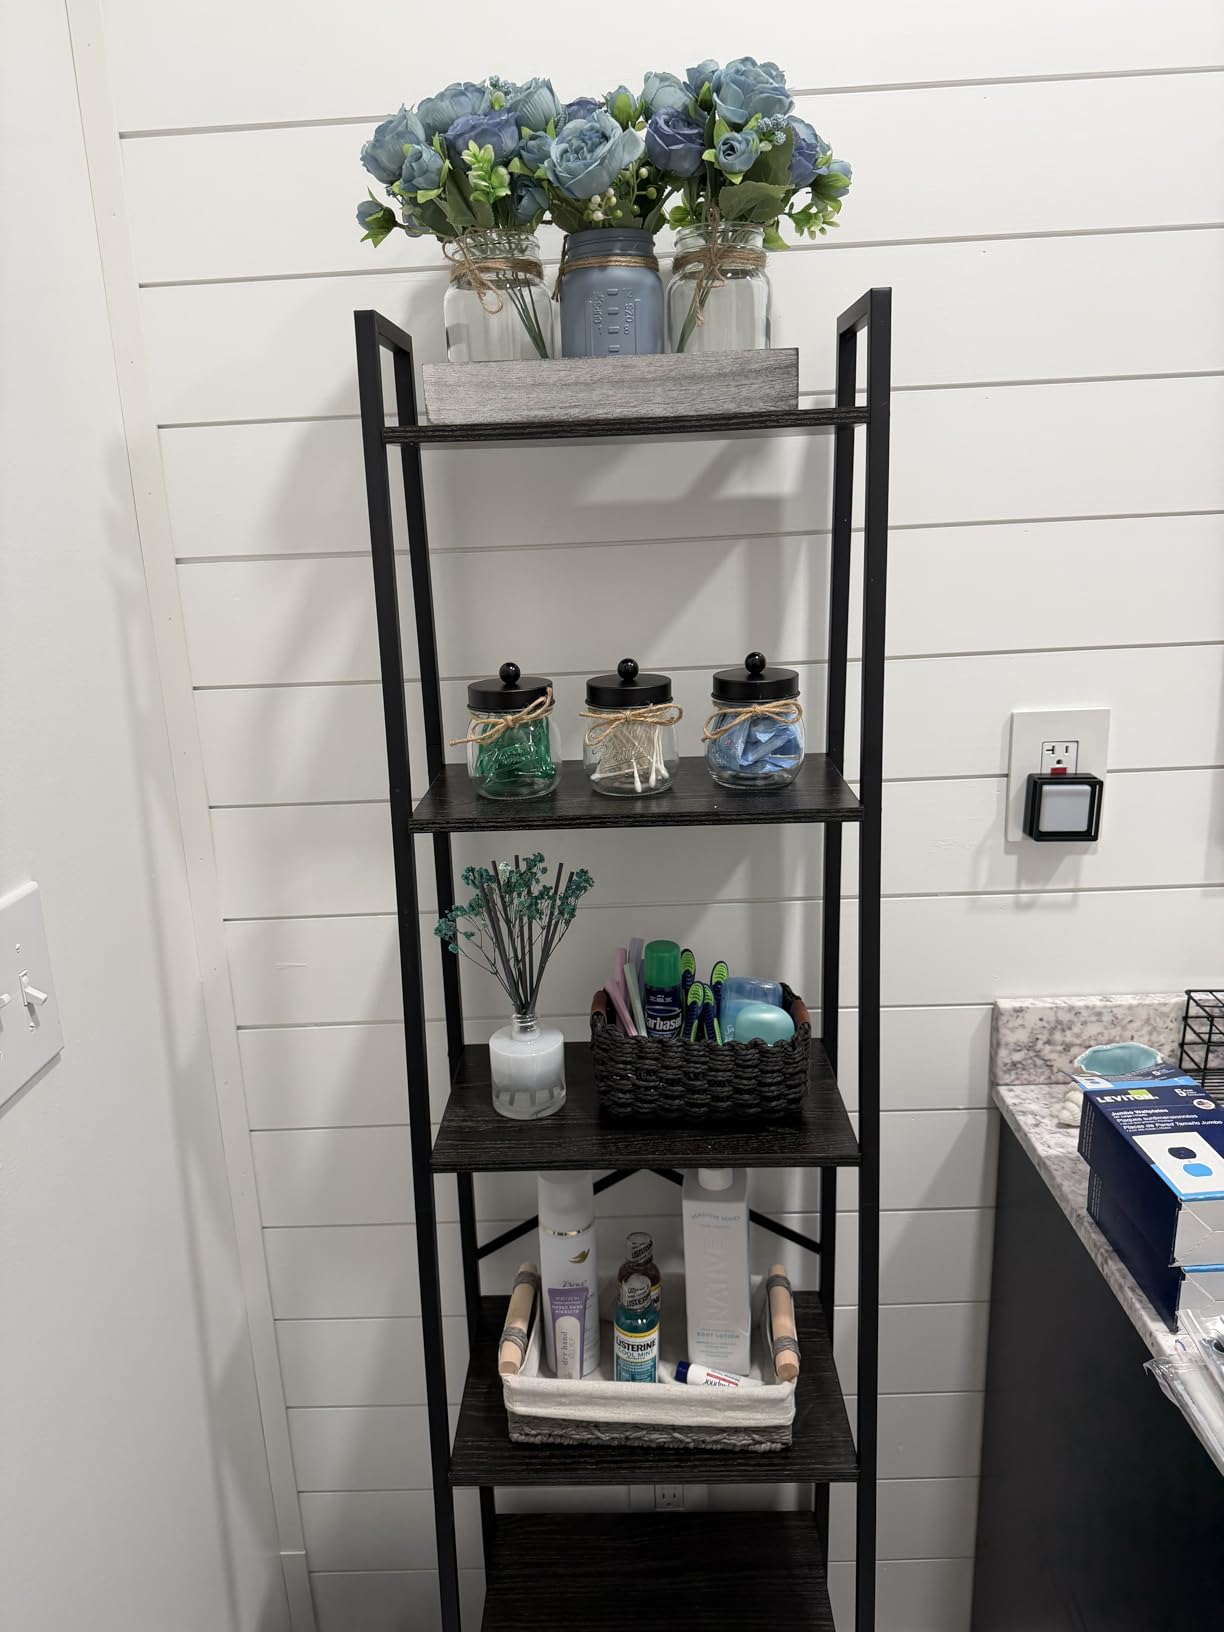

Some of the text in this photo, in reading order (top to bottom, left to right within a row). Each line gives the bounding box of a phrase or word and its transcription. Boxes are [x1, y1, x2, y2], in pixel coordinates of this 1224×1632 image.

[645, 1012, 682, 1031] arbasol
[1096, 1093, 1155, 1104] LEVITON
[616, 1336, 656, 1352] LISTERINE
[617, 1347, 654, 1358] COOL MINT
